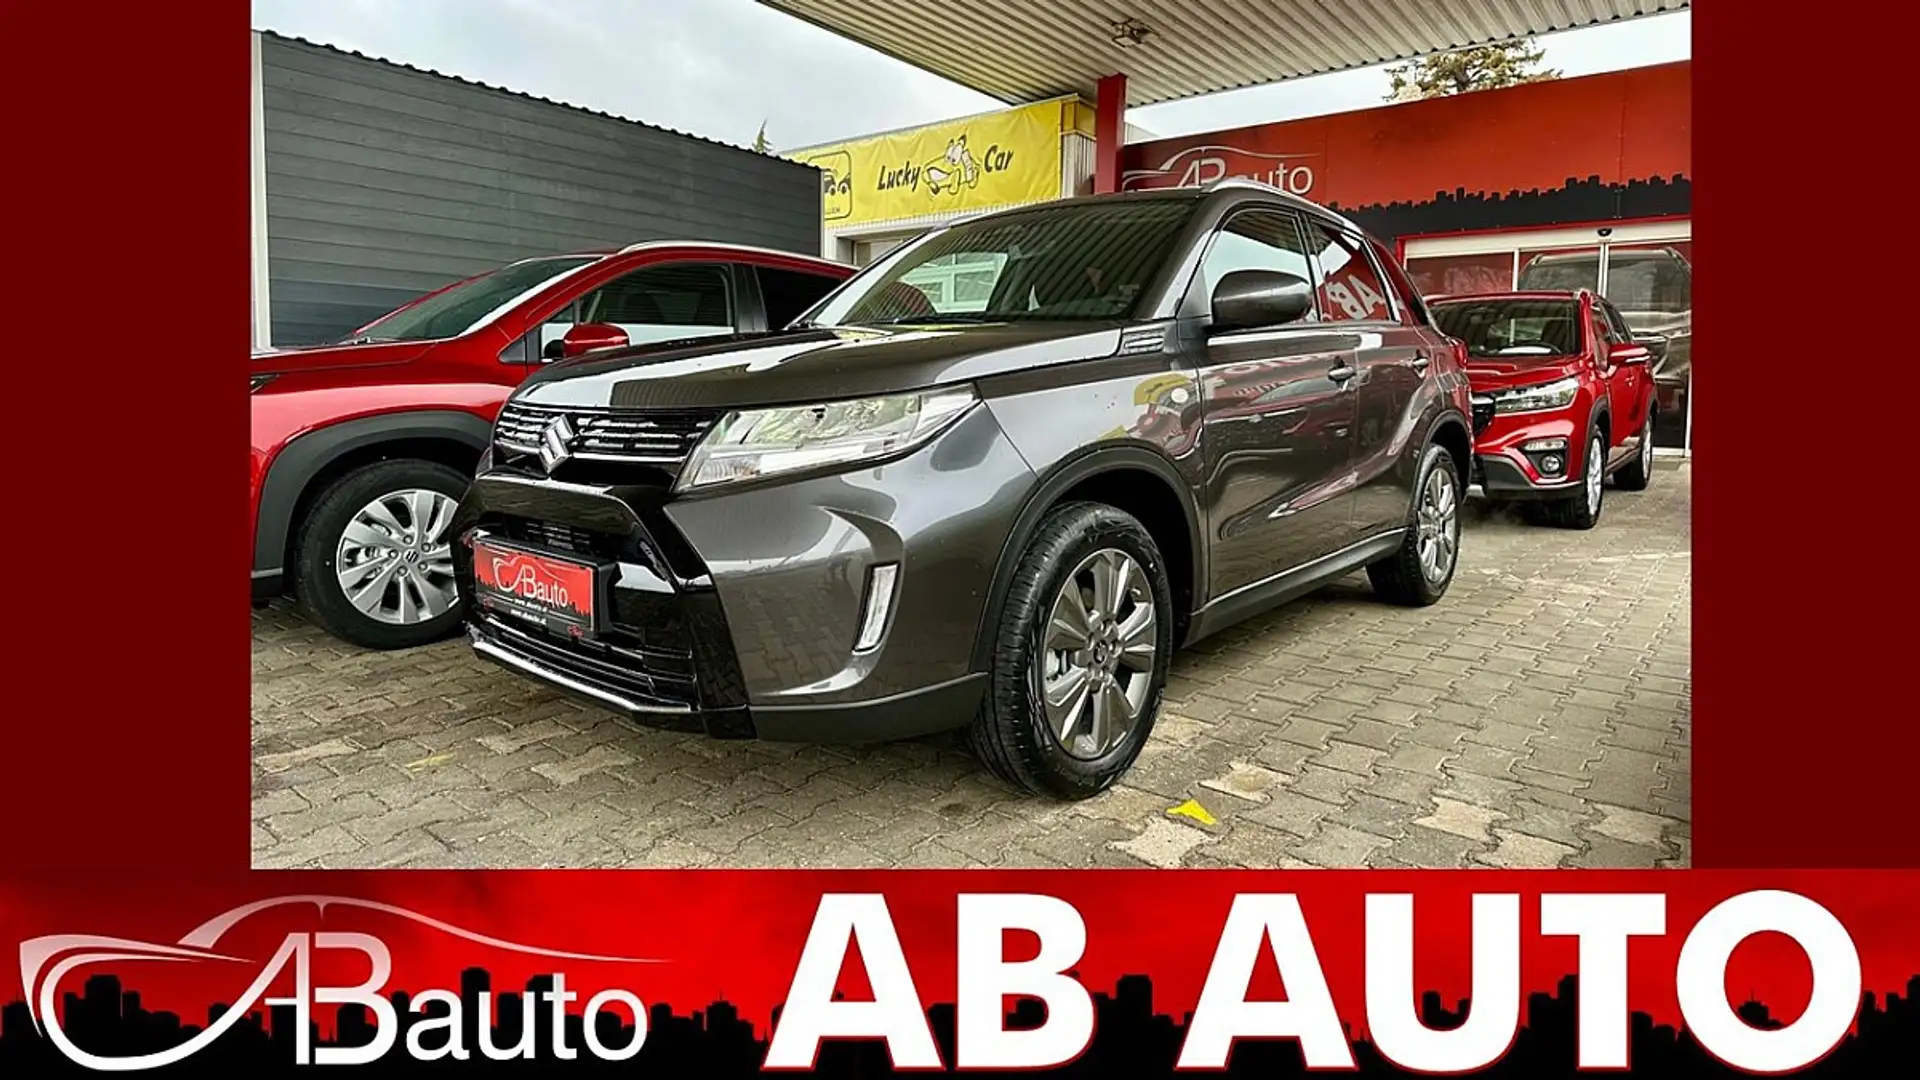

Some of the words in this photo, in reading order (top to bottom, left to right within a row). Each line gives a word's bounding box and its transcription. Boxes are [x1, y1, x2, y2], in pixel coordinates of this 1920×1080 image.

[877, 160, 921, 192] Lucky
[983, 144, 1014, 173] Car
[508, 563, 569, 607] ABauto
